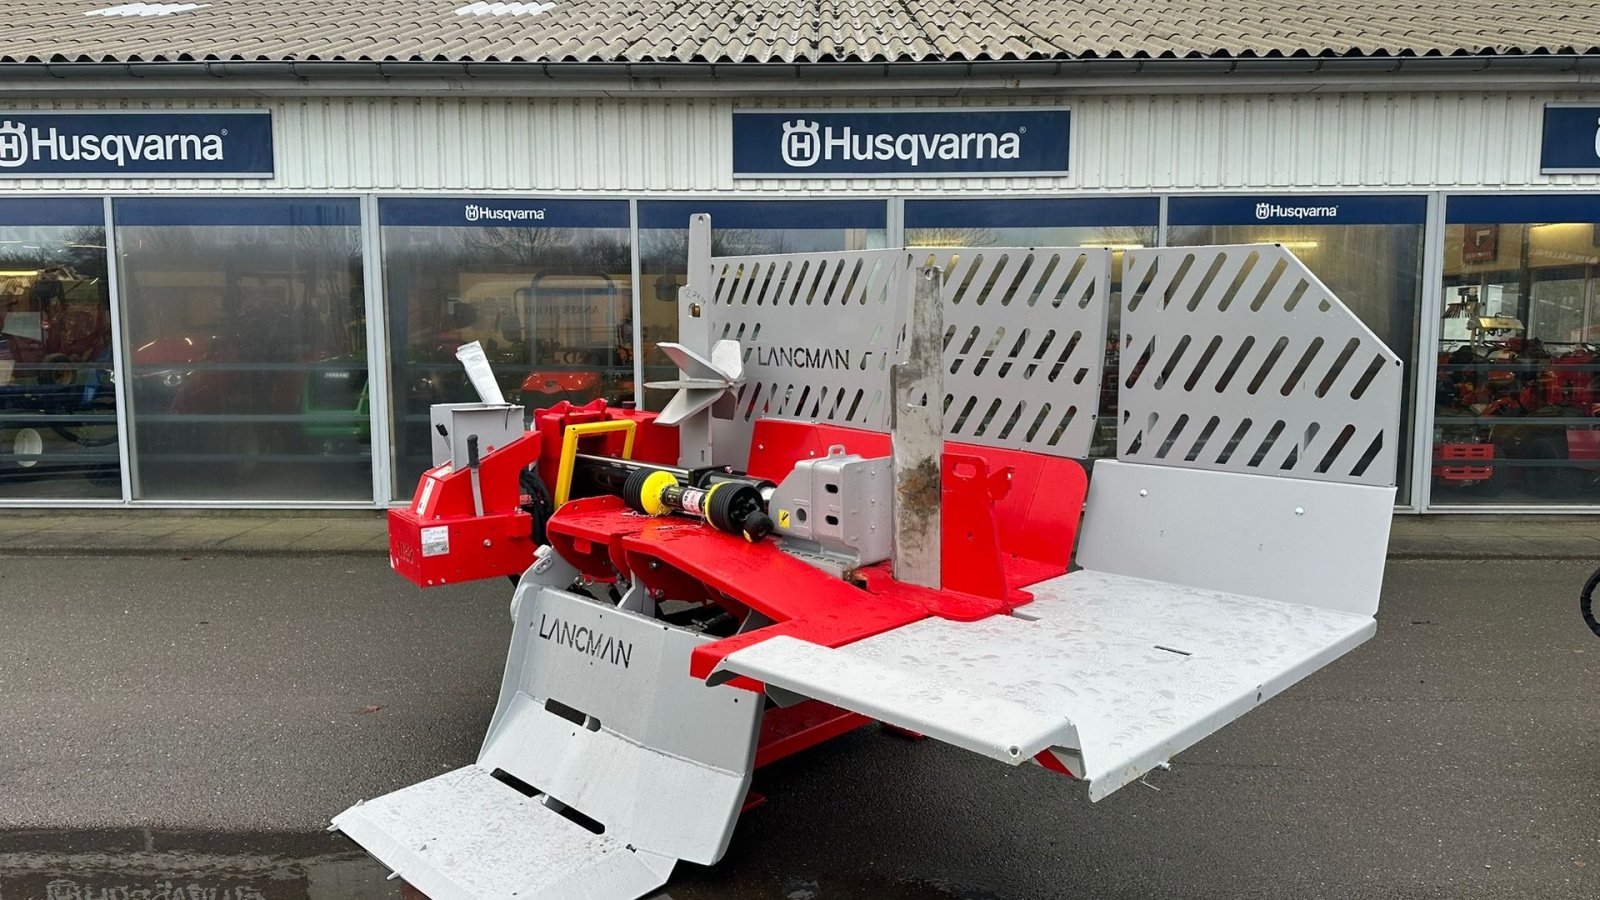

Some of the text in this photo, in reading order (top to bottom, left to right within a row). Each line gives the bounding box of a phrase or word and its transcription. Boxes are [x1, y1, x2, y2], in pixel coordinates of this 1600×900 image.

[31, 127, 224, 167] Husqvarna
[824, 126, 1020, 166] Husqvarna
[479, 206, 545, 221] Husqvarna
[1270, 204, 1337, 219] Husqvarna
[758, 346, 849, 370] LANCMAN
[539, 613, 633, 669] LANCMAN
